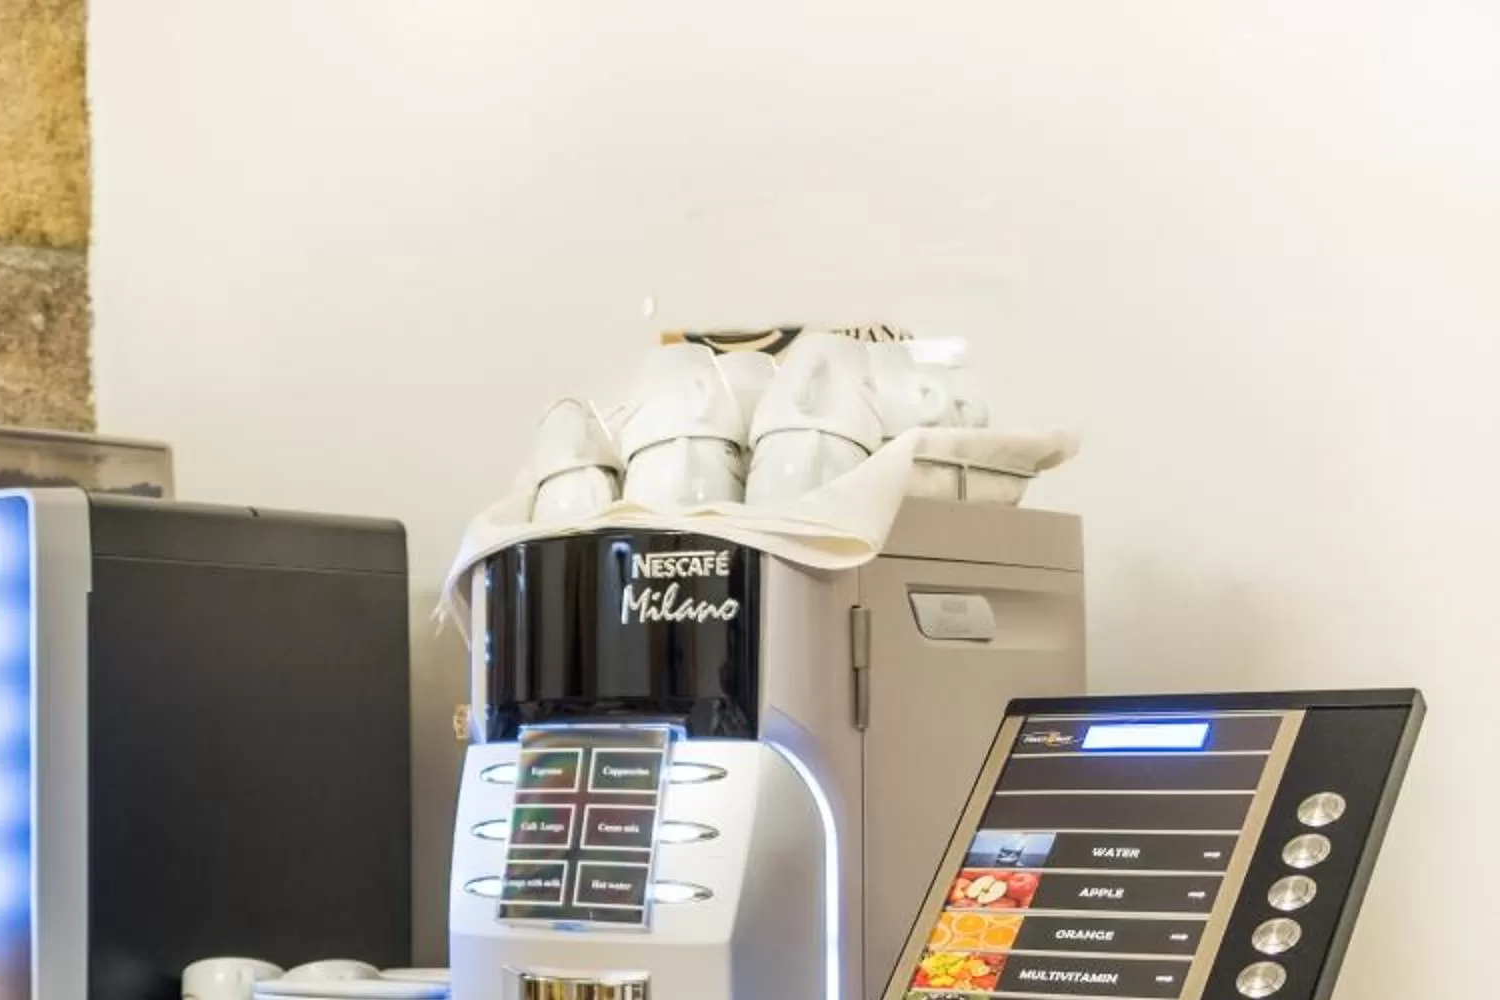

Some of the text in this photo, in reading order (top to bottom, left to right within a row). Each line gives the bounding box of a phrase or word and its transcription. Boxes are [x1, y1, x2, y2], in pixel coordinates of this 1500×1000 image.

[631, 550, 730, 579] NESCAFÉ
[621, 581, 739, 625] Milano
[1092, 847, 1140, 859] WATER
[1078, 887, 1125, 899] APPLE
[1055, 929, 1115, 941] ORANGE
[1019, 969, 1119, 985] MULTIVITAMIN
